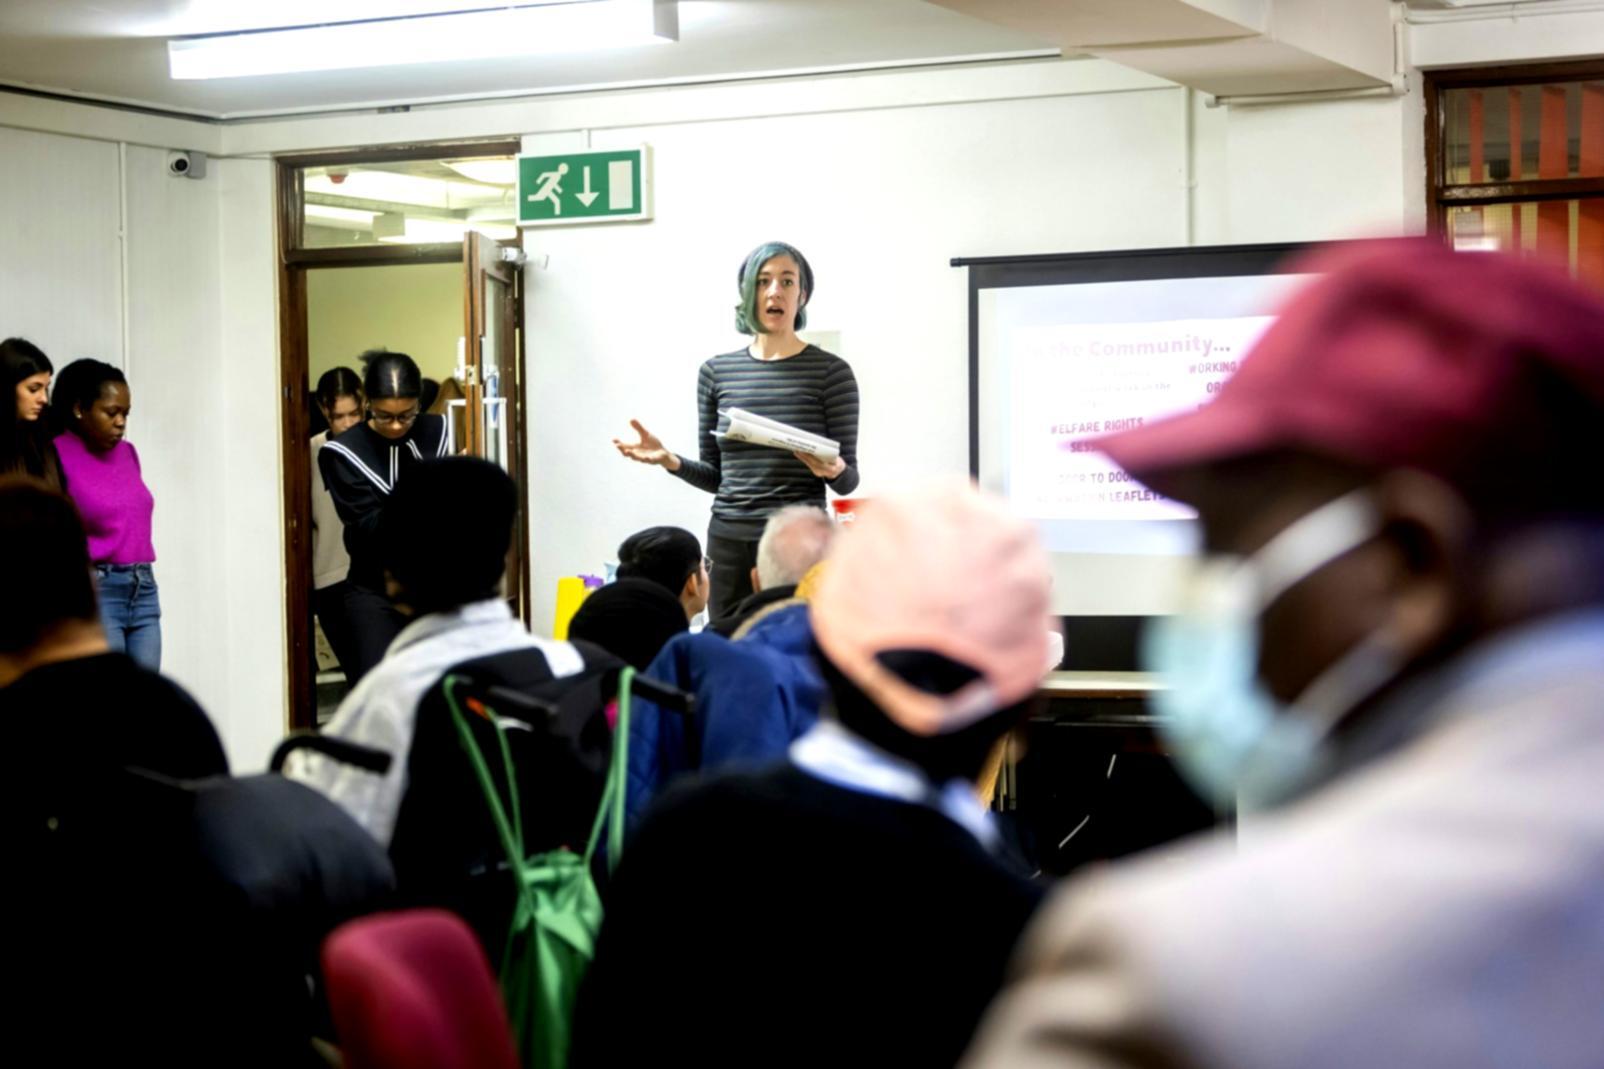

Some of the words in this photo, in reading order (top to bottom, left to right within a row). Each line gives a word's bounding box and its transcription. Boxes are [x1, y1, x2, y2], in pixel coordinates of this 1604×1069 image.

[1090, 335, 1231, 357] Community...
[1104, 417, 1144, 432] RIGHTS
[1091, 473, 1105, 485] TO
